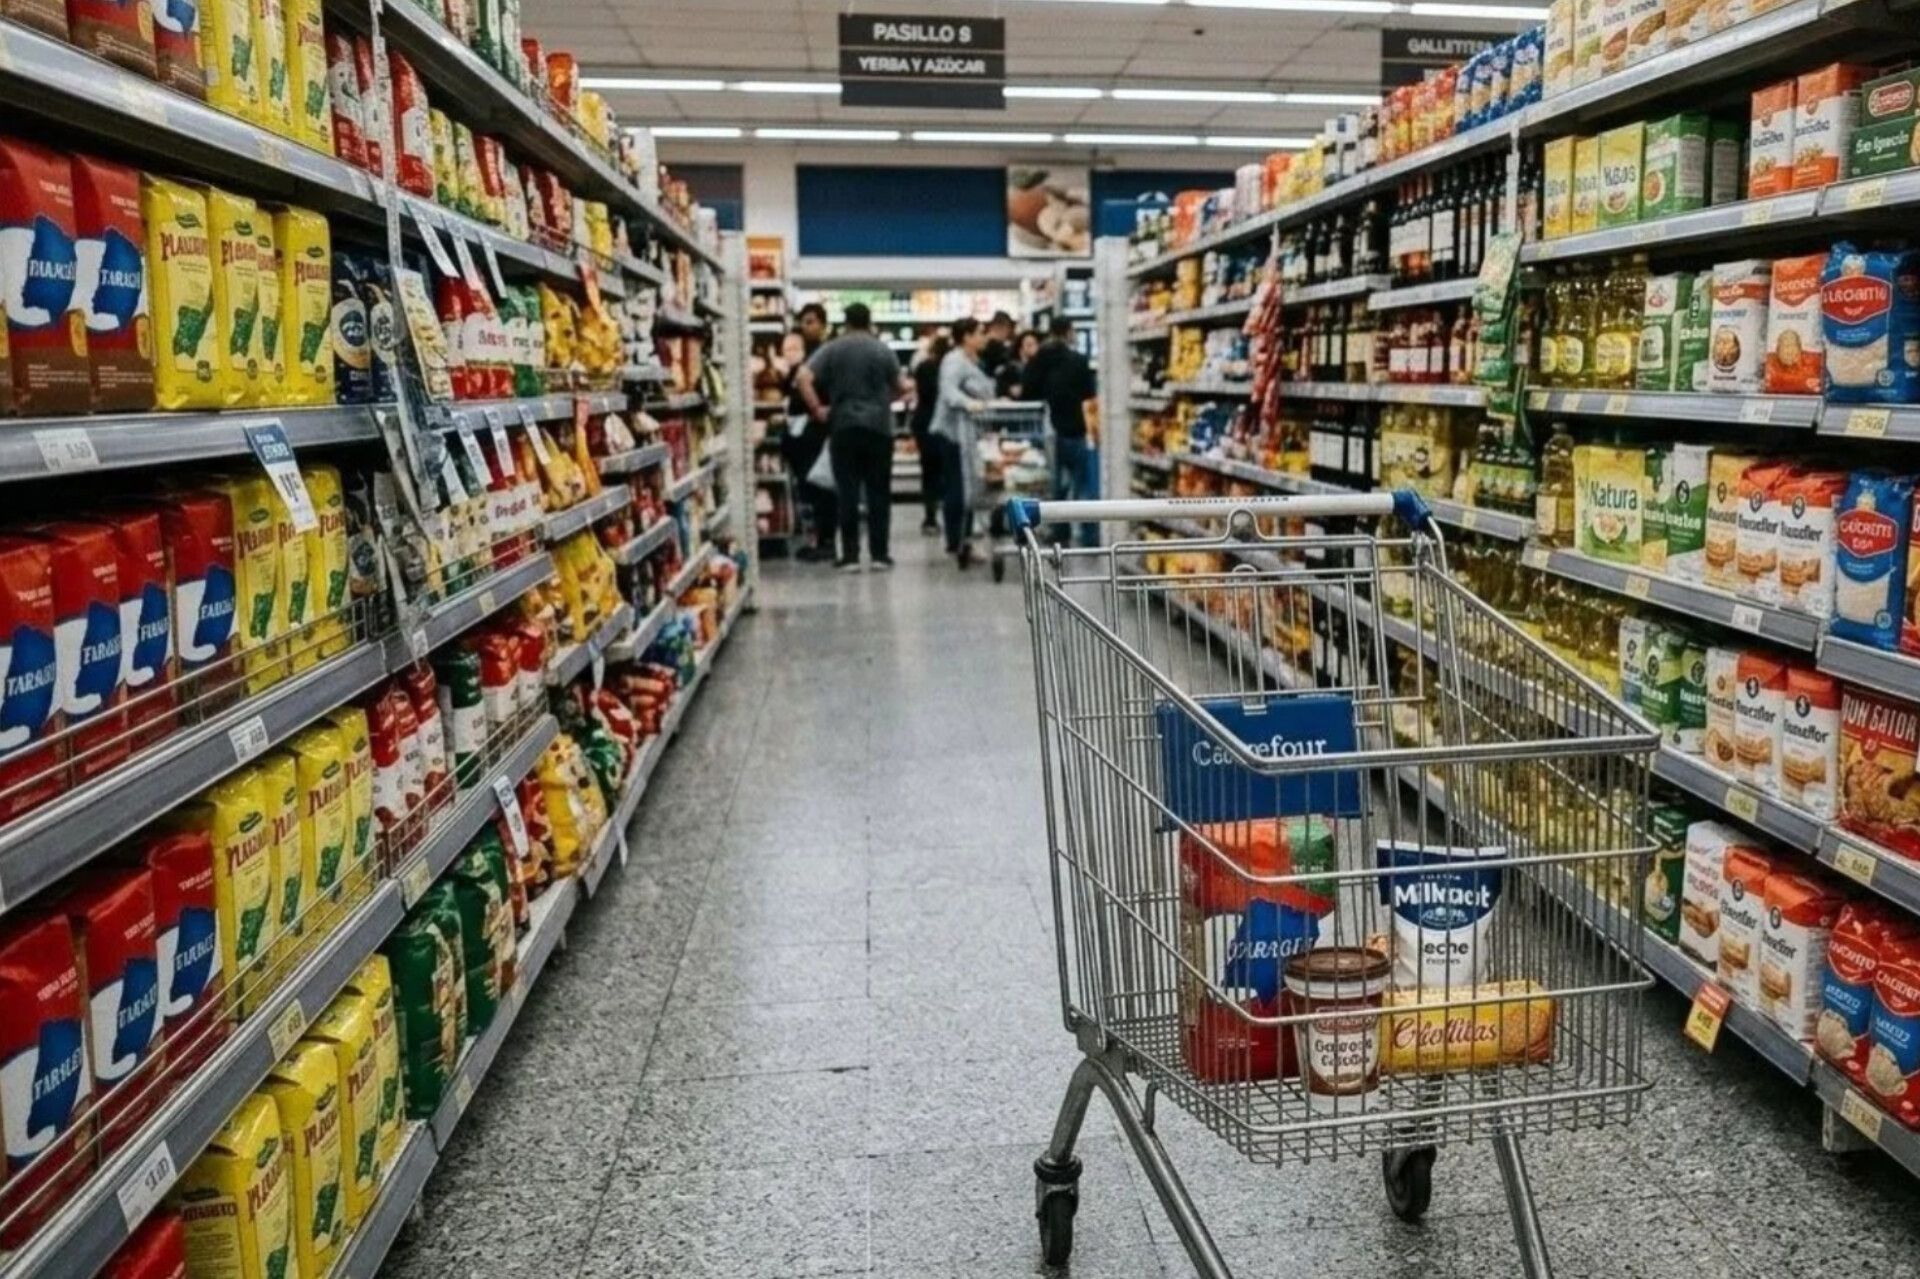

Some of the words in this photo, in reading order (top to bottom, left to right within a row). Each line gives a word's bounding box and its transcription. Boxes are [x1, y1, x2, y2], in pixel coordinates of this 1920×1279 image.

[873, 23, 954, 42] PASILLO
[859, 56, 909, 72] YERBA
[911, 57, 922, 73] Y
[1192, 734, 1325, 766] Carefour
[1424, 941, 1469, 956] eche
